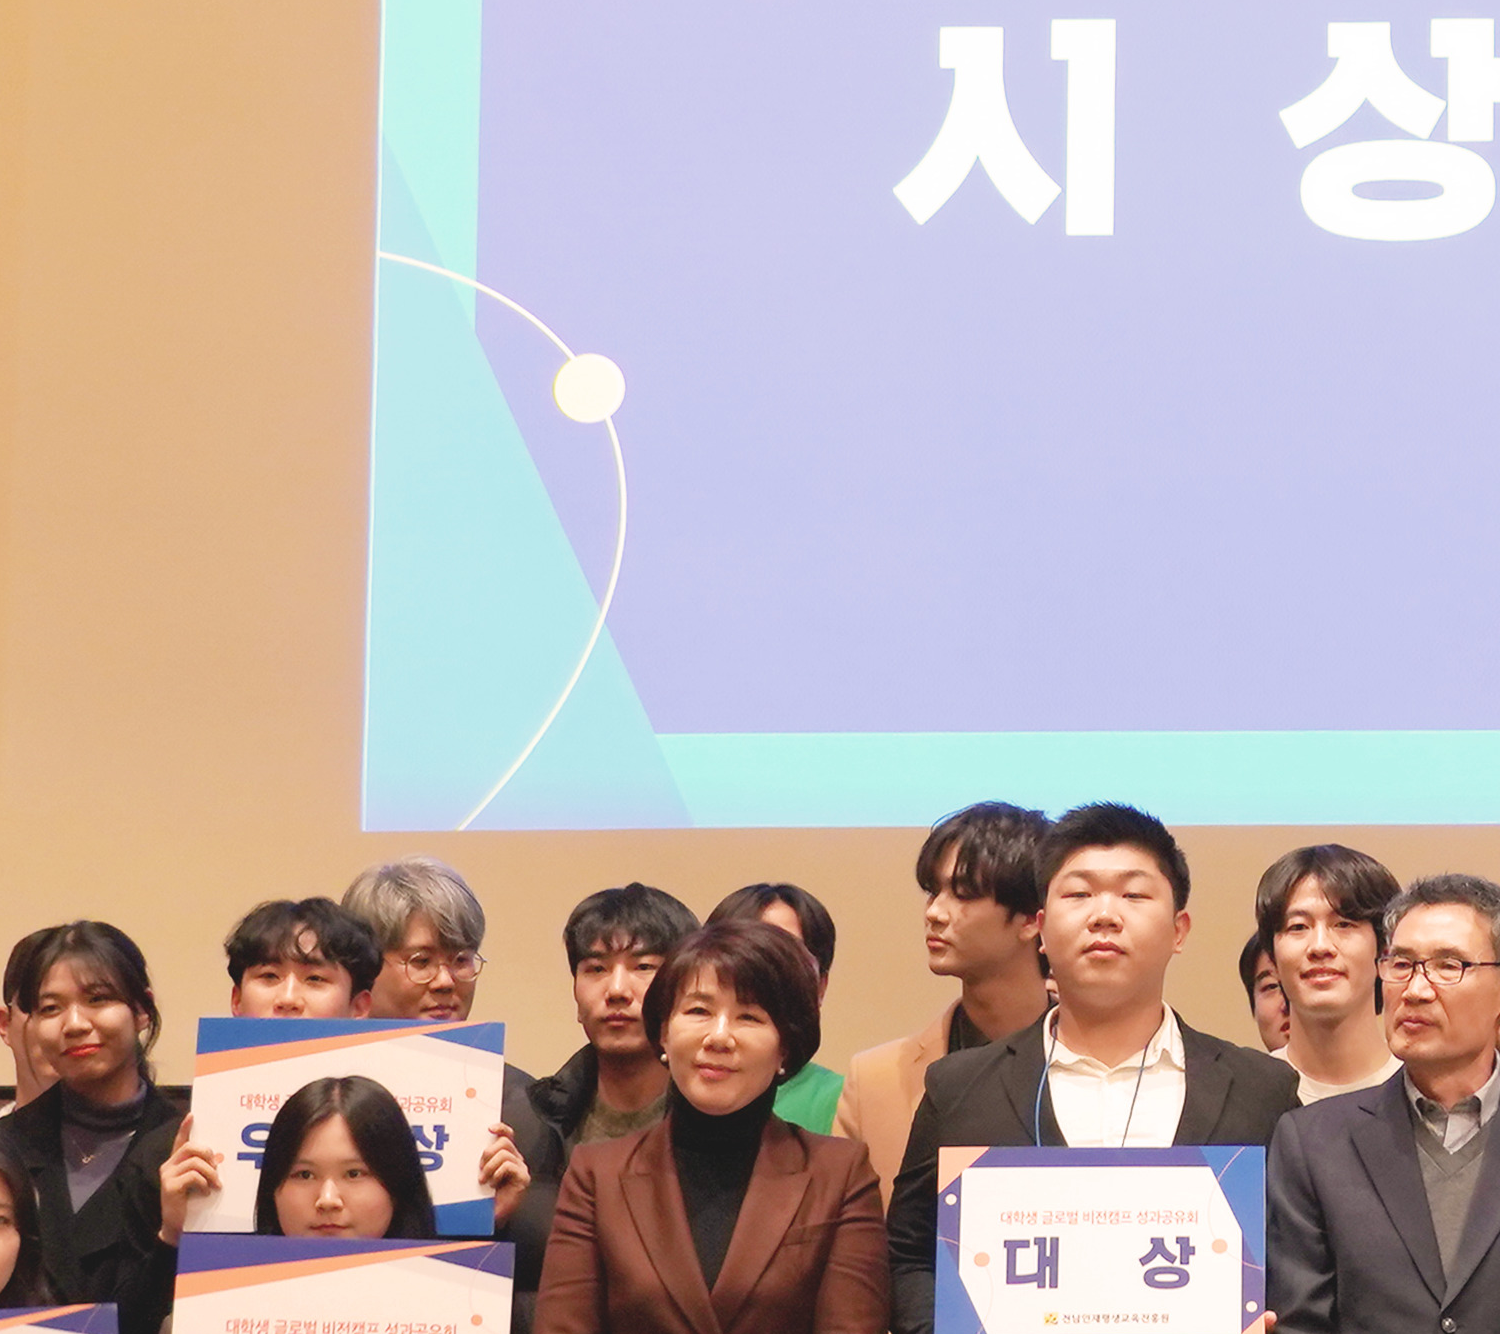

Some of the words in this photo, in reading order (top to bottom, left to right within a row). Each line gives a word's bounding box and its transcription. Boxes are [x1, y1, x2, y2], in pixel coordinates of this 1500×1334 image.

[240, 1094, 280, 1111] 대학생
[395, 1096, 453, 1114] 과공유회
[1000, 1211, 1037, 1225] 대학생
[1043, 1210, 1078, 1225] 글로벌
[1083, 1210, 1132, 1225] 비전캠프
[1137, 1210, 1198, 1225] 성과공유회
